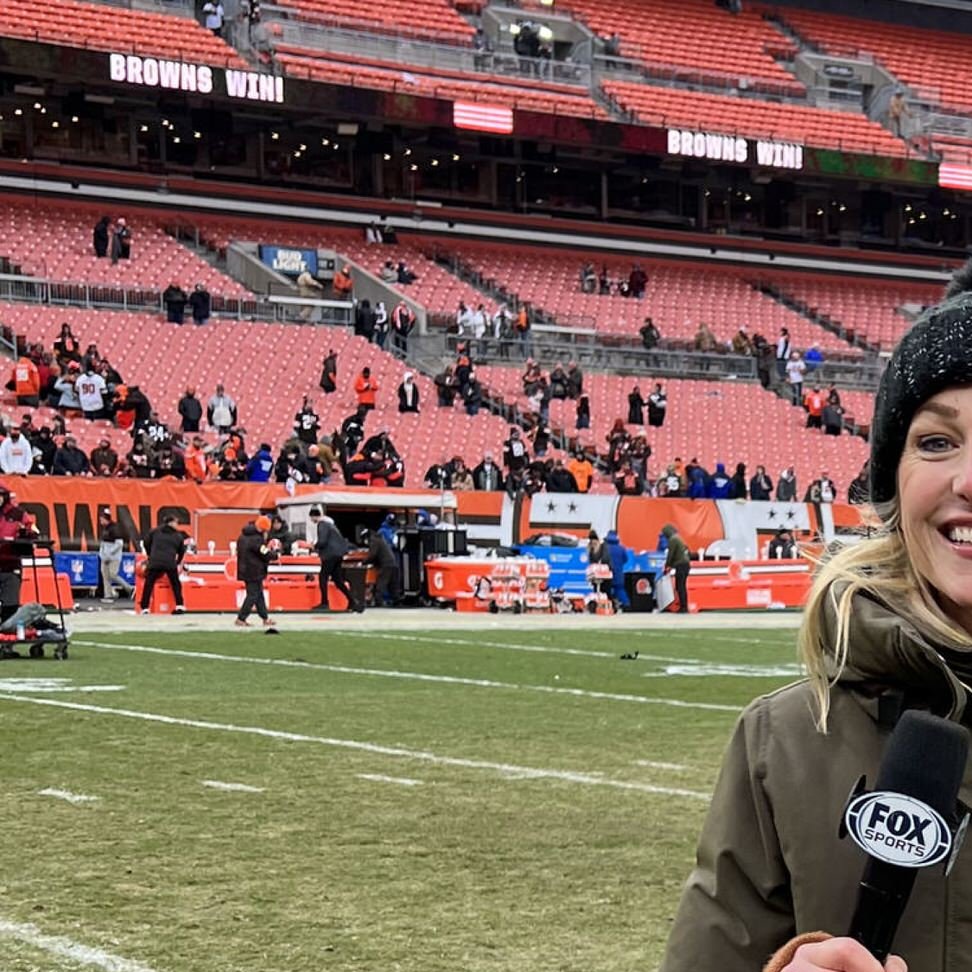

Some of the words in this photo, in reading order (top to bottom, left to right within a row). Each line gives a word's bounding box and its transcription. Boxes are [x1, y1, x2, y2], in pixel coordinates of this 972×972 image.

[110, 53, 212, 94] BROWNS
[225, 69, 284, 104] WIN!
[667, 129, 748, 162] BROWNS
[757, 141, 803, 169] WIN!
[864, 828, 926, 857] SPORTS
[868, 802, 931, 846] FOX
